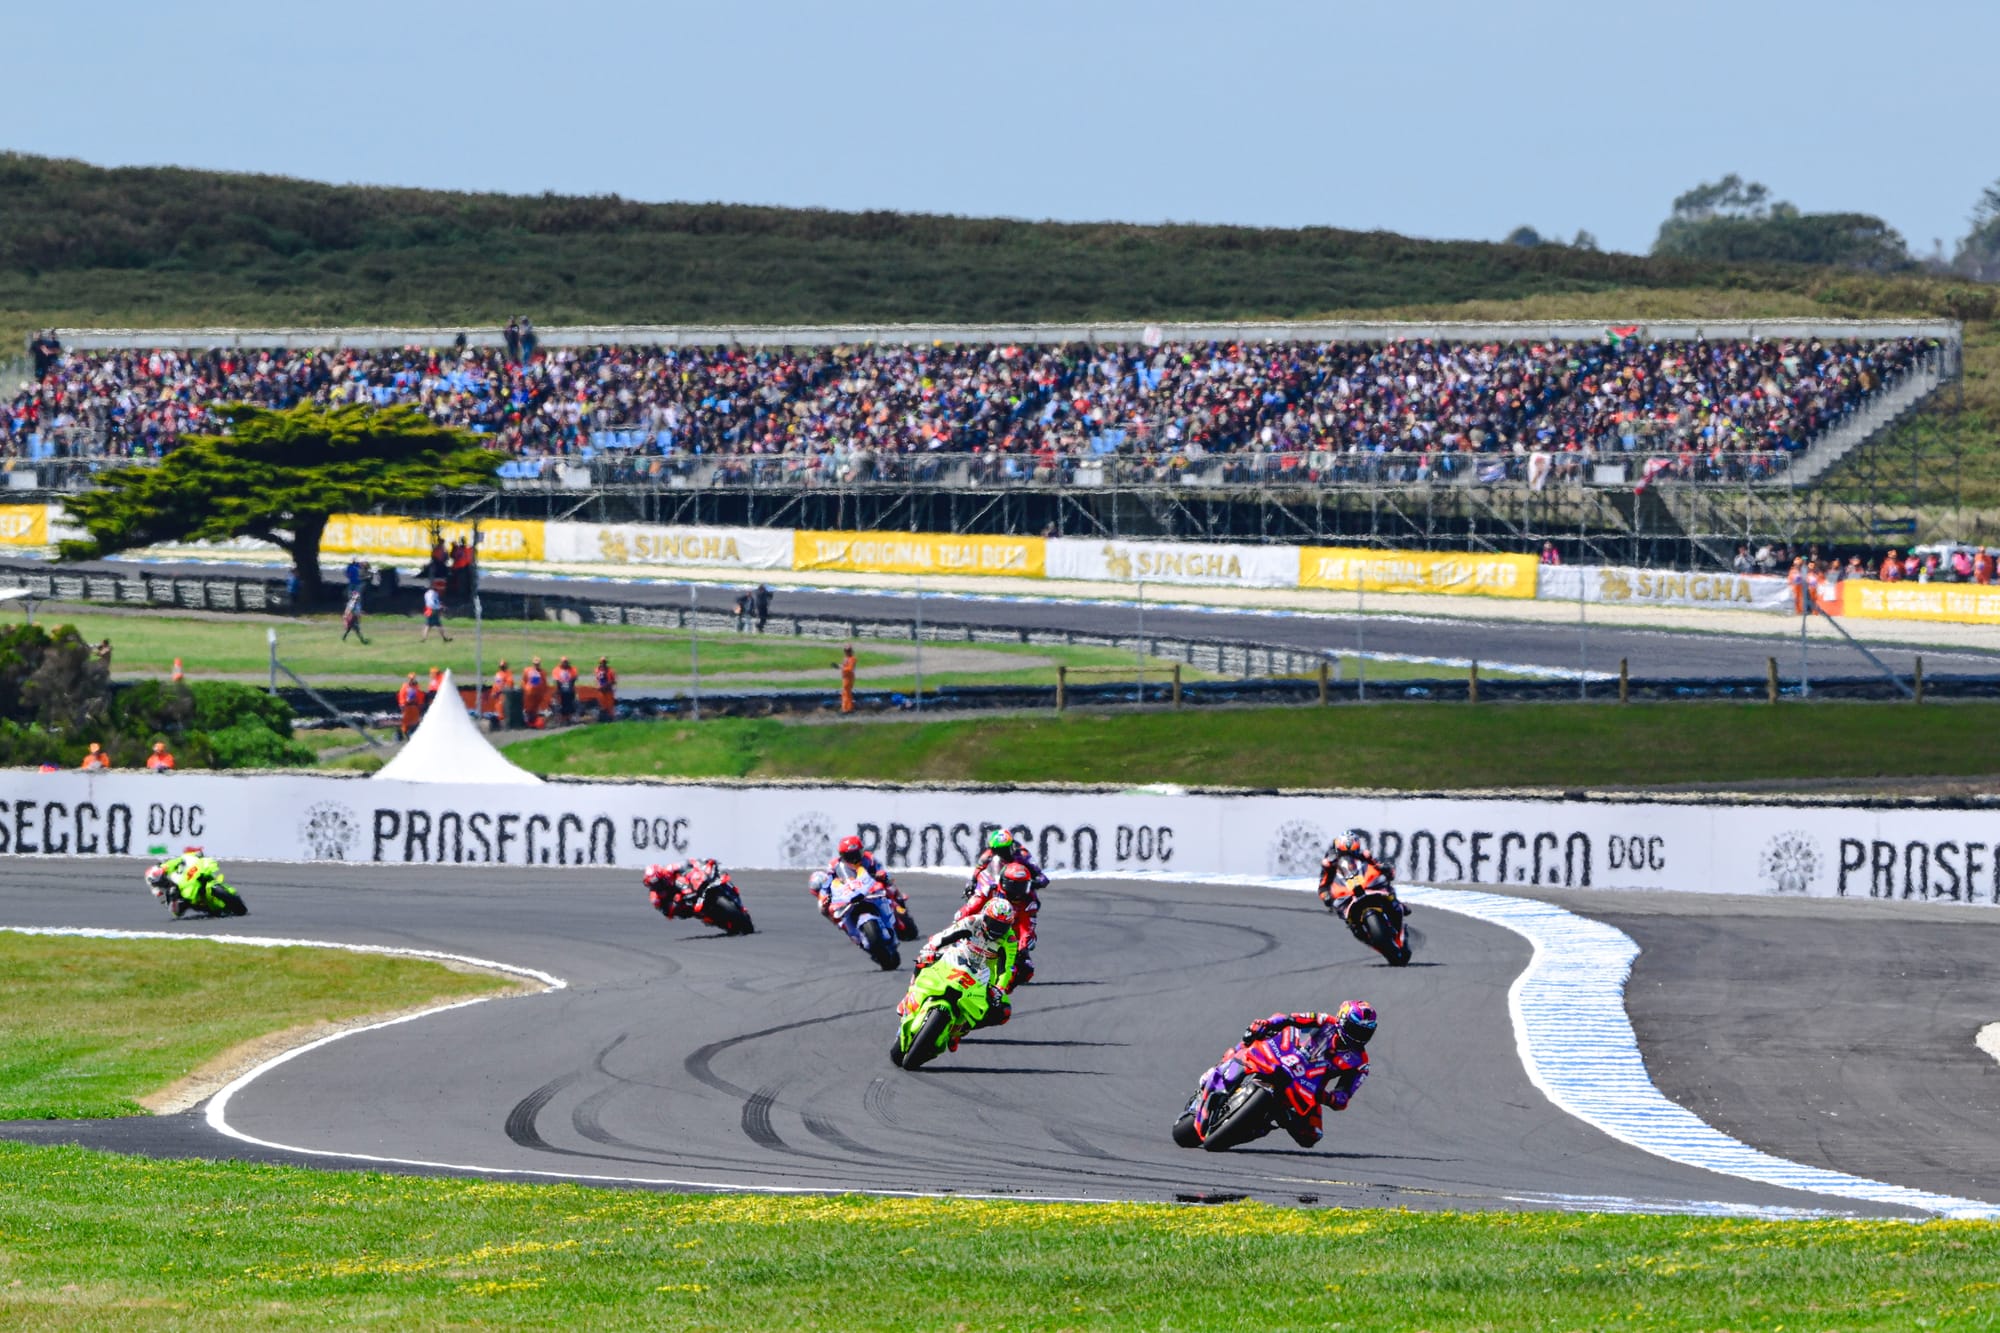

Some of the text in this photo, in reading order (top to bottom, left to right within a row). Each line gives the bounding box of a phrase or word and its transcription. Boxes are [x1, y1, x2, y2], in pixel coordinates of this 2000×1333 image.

[324, 522, 347, 548] HE
[635, 534, 740, 560] SINGHA
[815, 540, 1028, 569] THE ORIGINAL THAI BEER
[1137, 552, 1242, 577] SINGHA
[1318, 557, 1346, 580] THE
[1638, 574, 1752, 602] SINGHA
[148, 803, 204, 837] DOC
[373, 808, 689, 865] PROSECCO DOC
[1115, 825, 1174, 863] DOC
[1608, 834, 1665, 871] DOC
[947, 968, 976, 989] 72
[1280, 1054, 1305, 1077] 89
